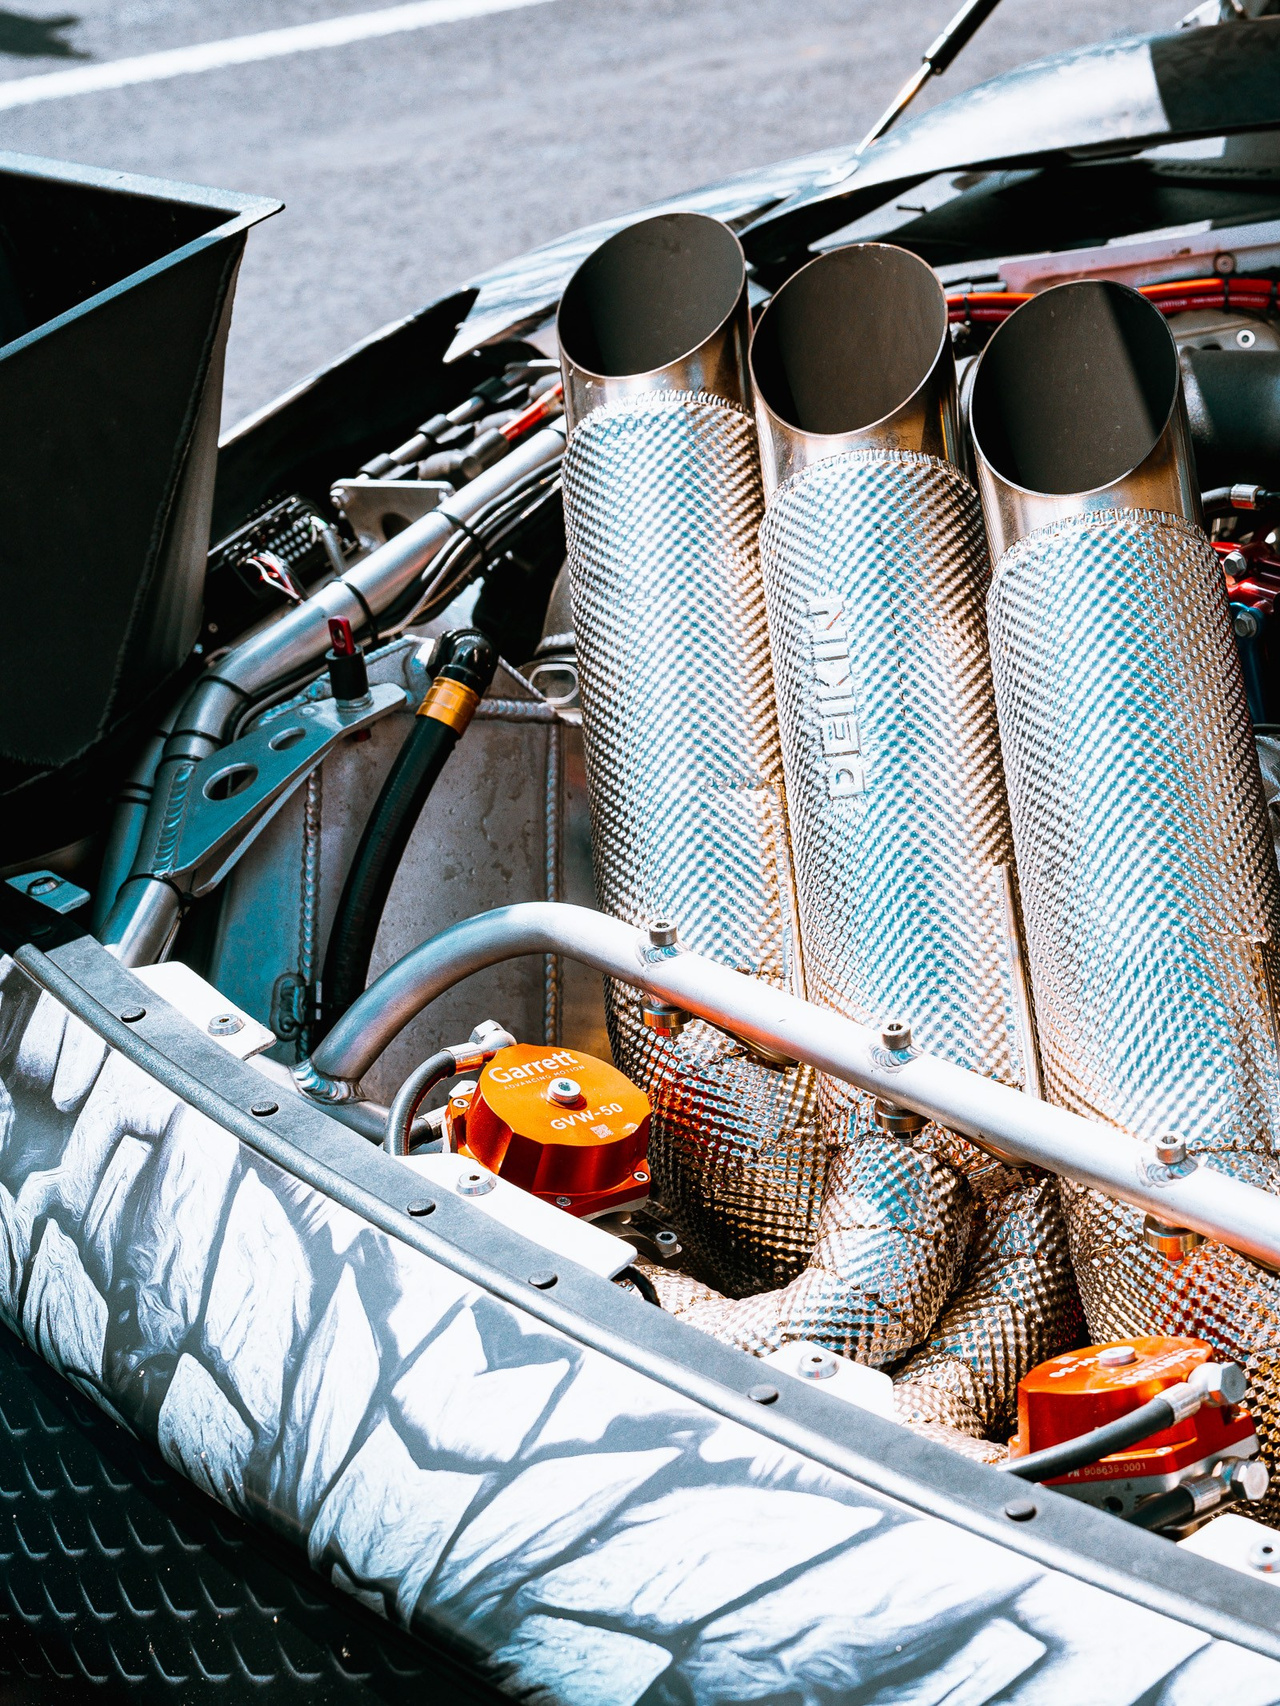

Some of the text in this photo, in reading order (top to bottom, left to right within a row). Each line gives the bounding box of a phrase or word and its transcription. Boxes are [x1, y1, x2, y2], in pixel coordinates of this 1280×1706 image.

[488, 1051, 578, 1083] Garrett
[504, 1064, 585, 1090] ADVANCING MOTION
[550, 1102, 623, 1130] GVW-50
